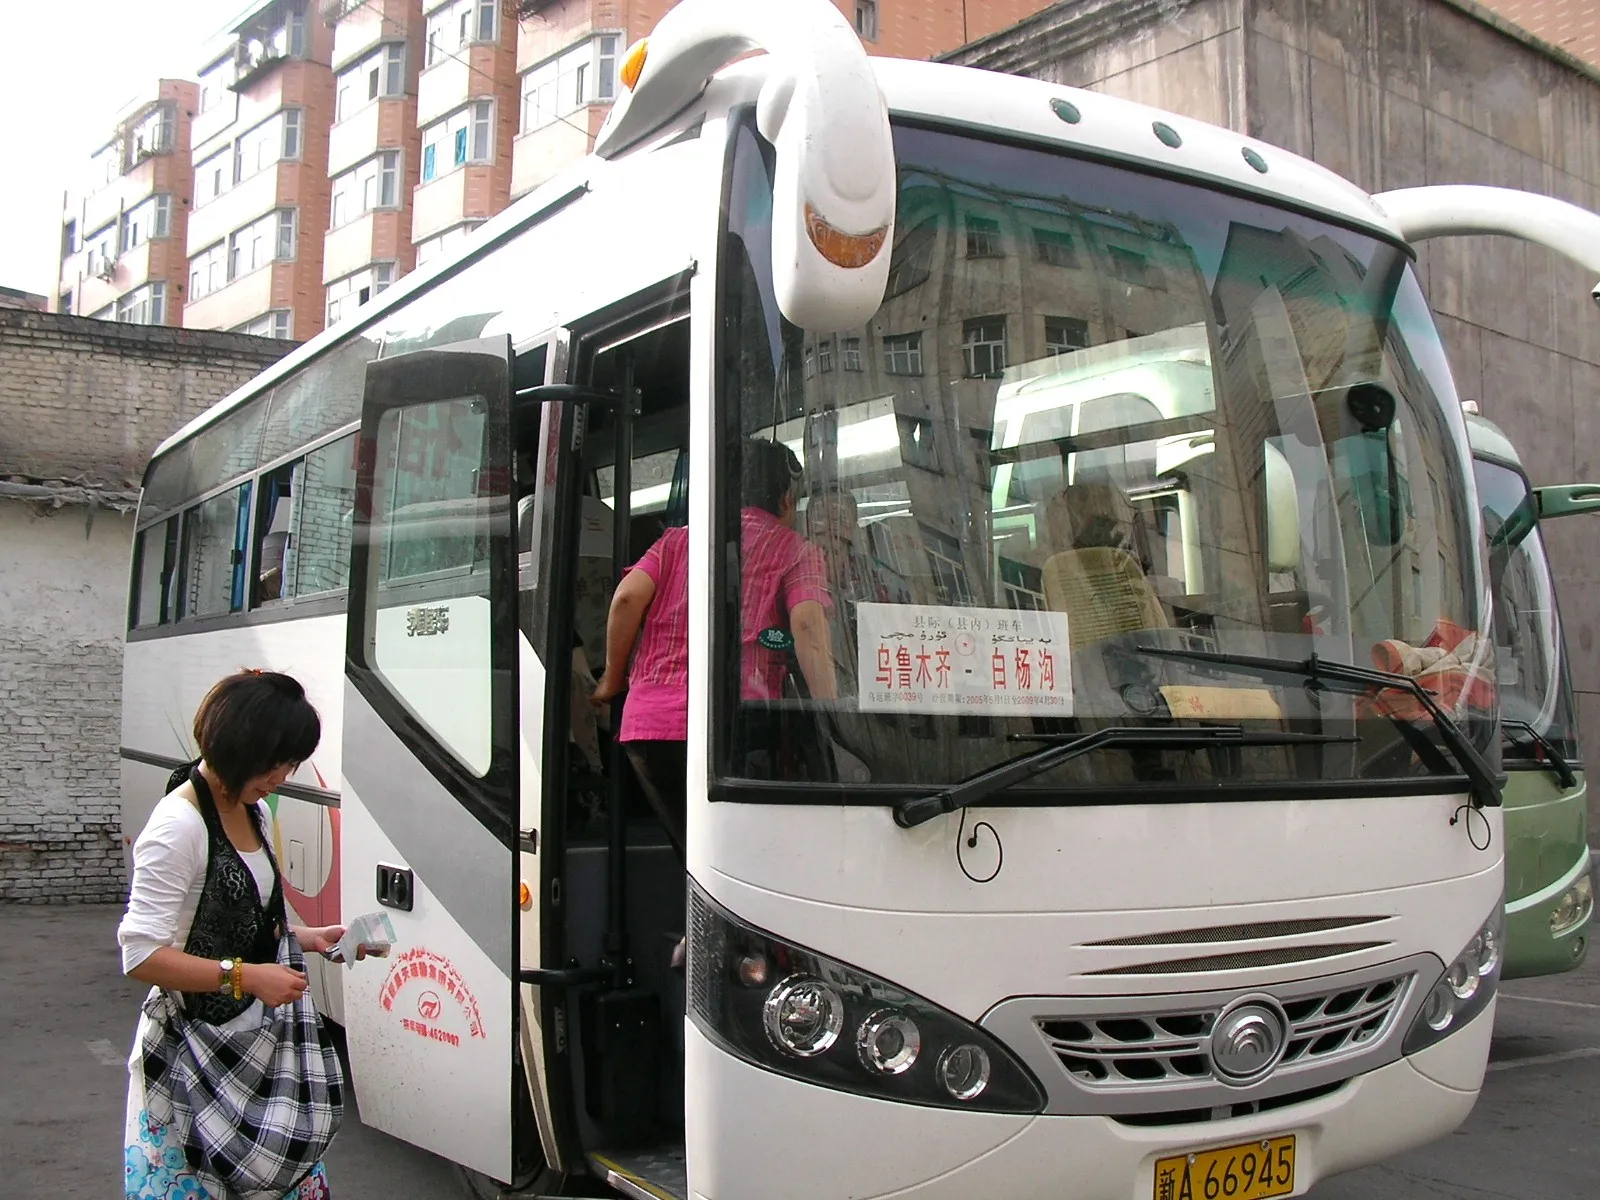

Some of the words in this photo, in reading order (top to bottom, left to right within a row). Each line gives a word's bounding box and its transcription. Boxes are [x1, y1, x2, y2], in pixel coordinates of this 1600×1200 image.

[875, 643, 951, 690] 乌鲁木齐
[991, 646, 1056, 691] 白杨沟
